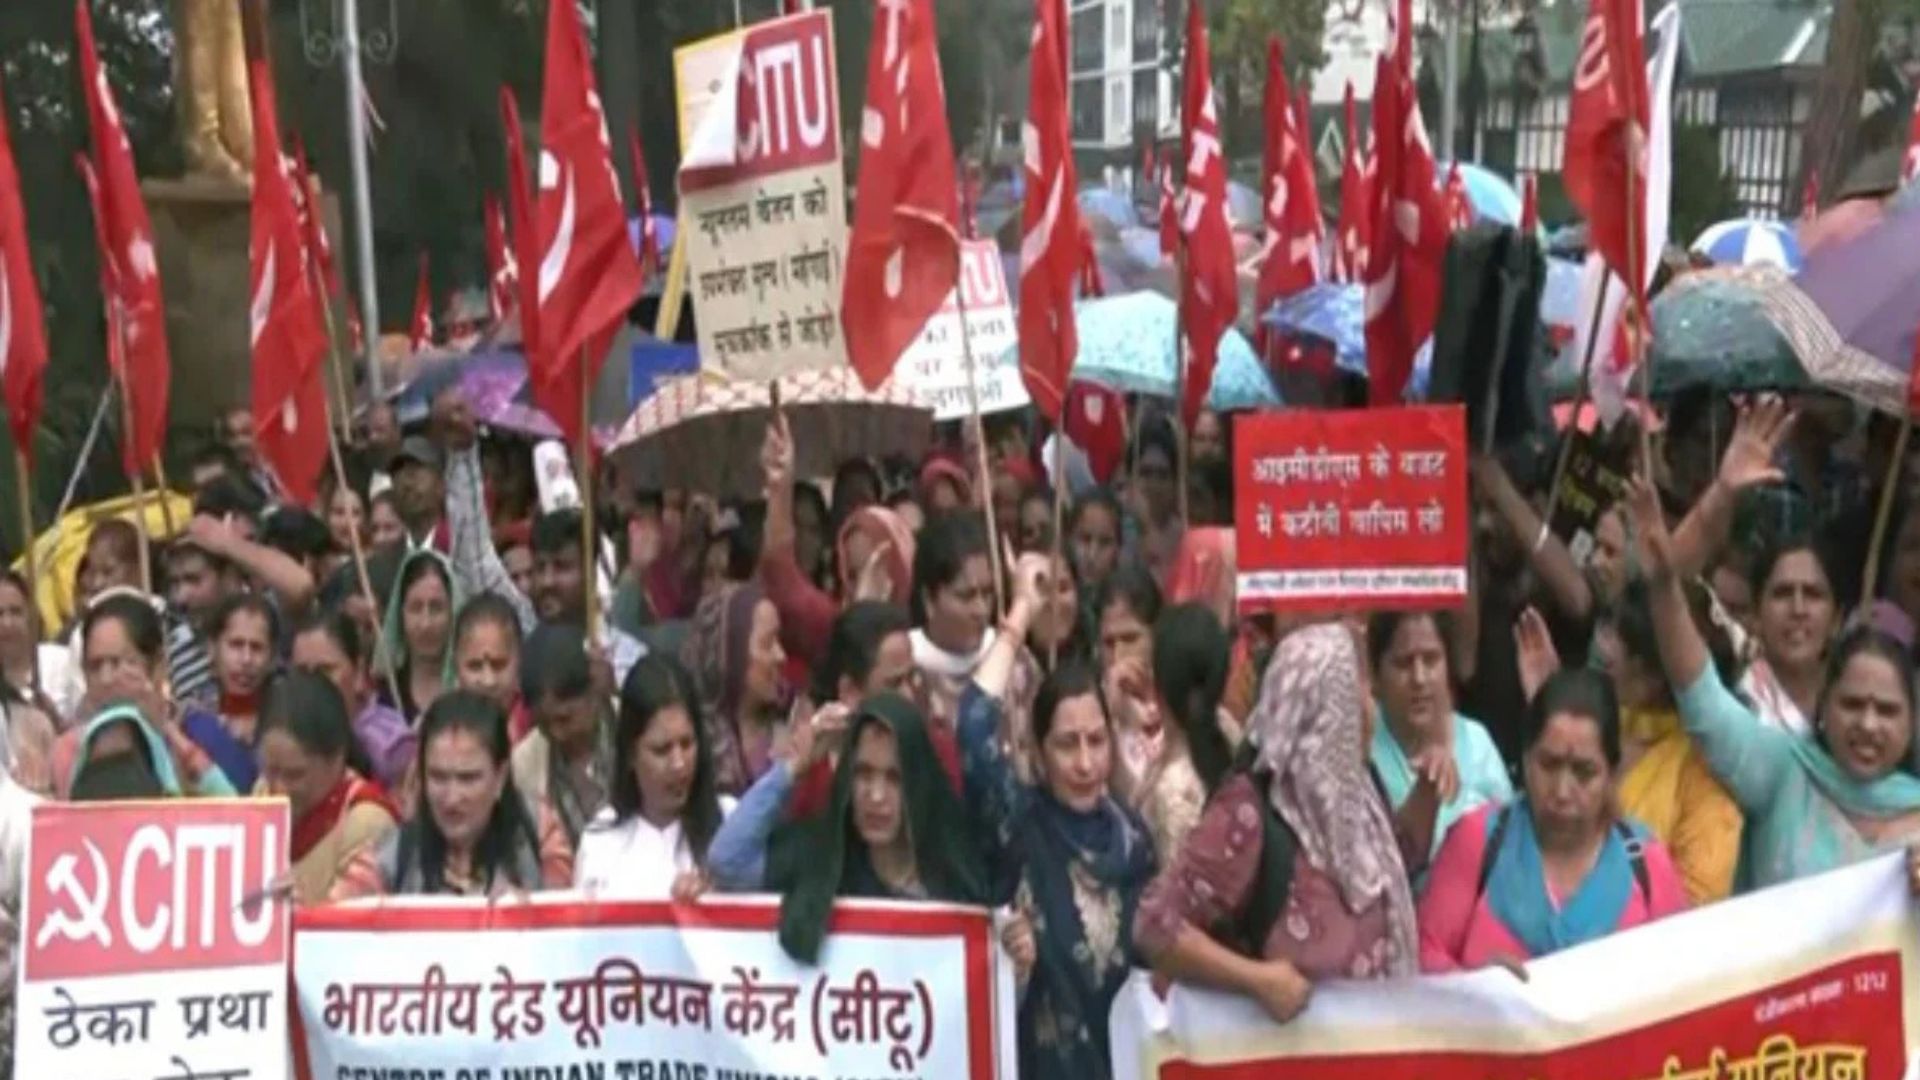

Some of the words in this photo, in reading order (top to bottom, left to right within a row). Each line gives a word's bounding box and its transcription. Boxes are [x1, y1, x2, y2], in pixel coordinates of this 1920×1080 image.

[737, 35, 828, 163] CITU
[802, 177, 826, 216] को
[1367, 441, 1391, 477] के
[119, 822, 278, 953] CITU
[43, 985, 155, 1048] ठेका
[178, 990, 272, 1040] प्रथा
[322, 963, 481, 1036] भारतीय
[490, 963, 545, 1041] ट्रेड
[553, 958, 714, 1048] यूनियन
[722, 965, 801, 1043] केंद्र
[811, 969, 934, 1072] (सीटू)
[614, 1059, 709, 1080] TRADE
